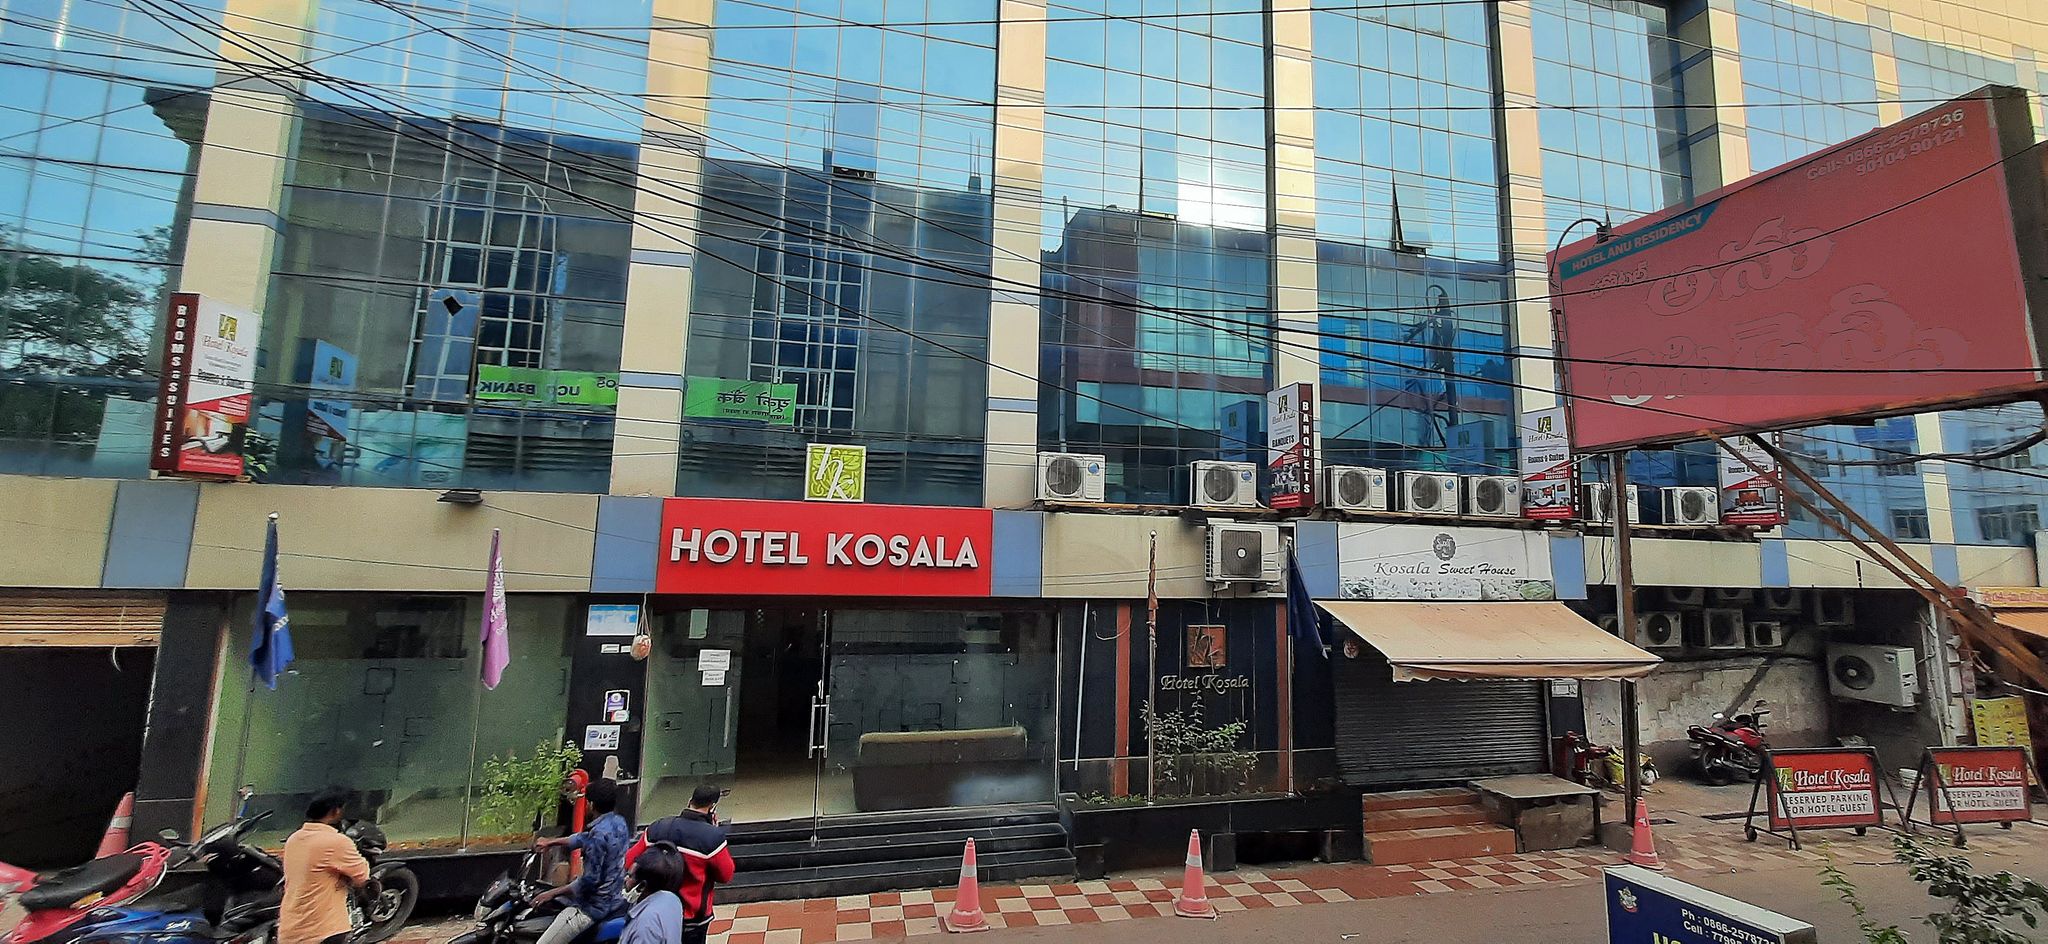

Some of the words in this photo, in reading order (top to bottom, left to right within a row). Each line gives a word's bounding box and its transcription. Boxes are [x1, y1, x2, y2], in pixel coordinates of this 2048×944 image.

[1572, 253, 1605, 273] HOTEL
[1607, 241, 1633, 258] ANU
[1634, 211, 1703, 248] RESIDENCY
[171, 304, 187, 366] ROOMS
[160, 382, 178, 457] SUITES
[1302, 401, 1311, 494] BANQUETS
[669, 527, 809, 566] HOTEL
[826, 533, 979, 569] KOSALA
[1373, 561, 1431, 577] Kosala
[1438, 563, 1475, 576] Sweet
[1477, 562, 1517, 576] House
[1161, 675, 1201, 691] Hotel
[1202, 674, 1250, 695] Kosala
[1794, 769, 1829, 787] Hotel
[1830, 768, 1871, 790] Kosala
[1952, 766, 1983, 781] Hotel
[1831, 793, 1868, 803] PARKING
[1948, 791, 1982, 799] SERVED
[1808, 805, 1836, 814] HOTEL
[1840, 803, 1867, 813] GUEST
[1681, 908, 1695, 921] Ph
